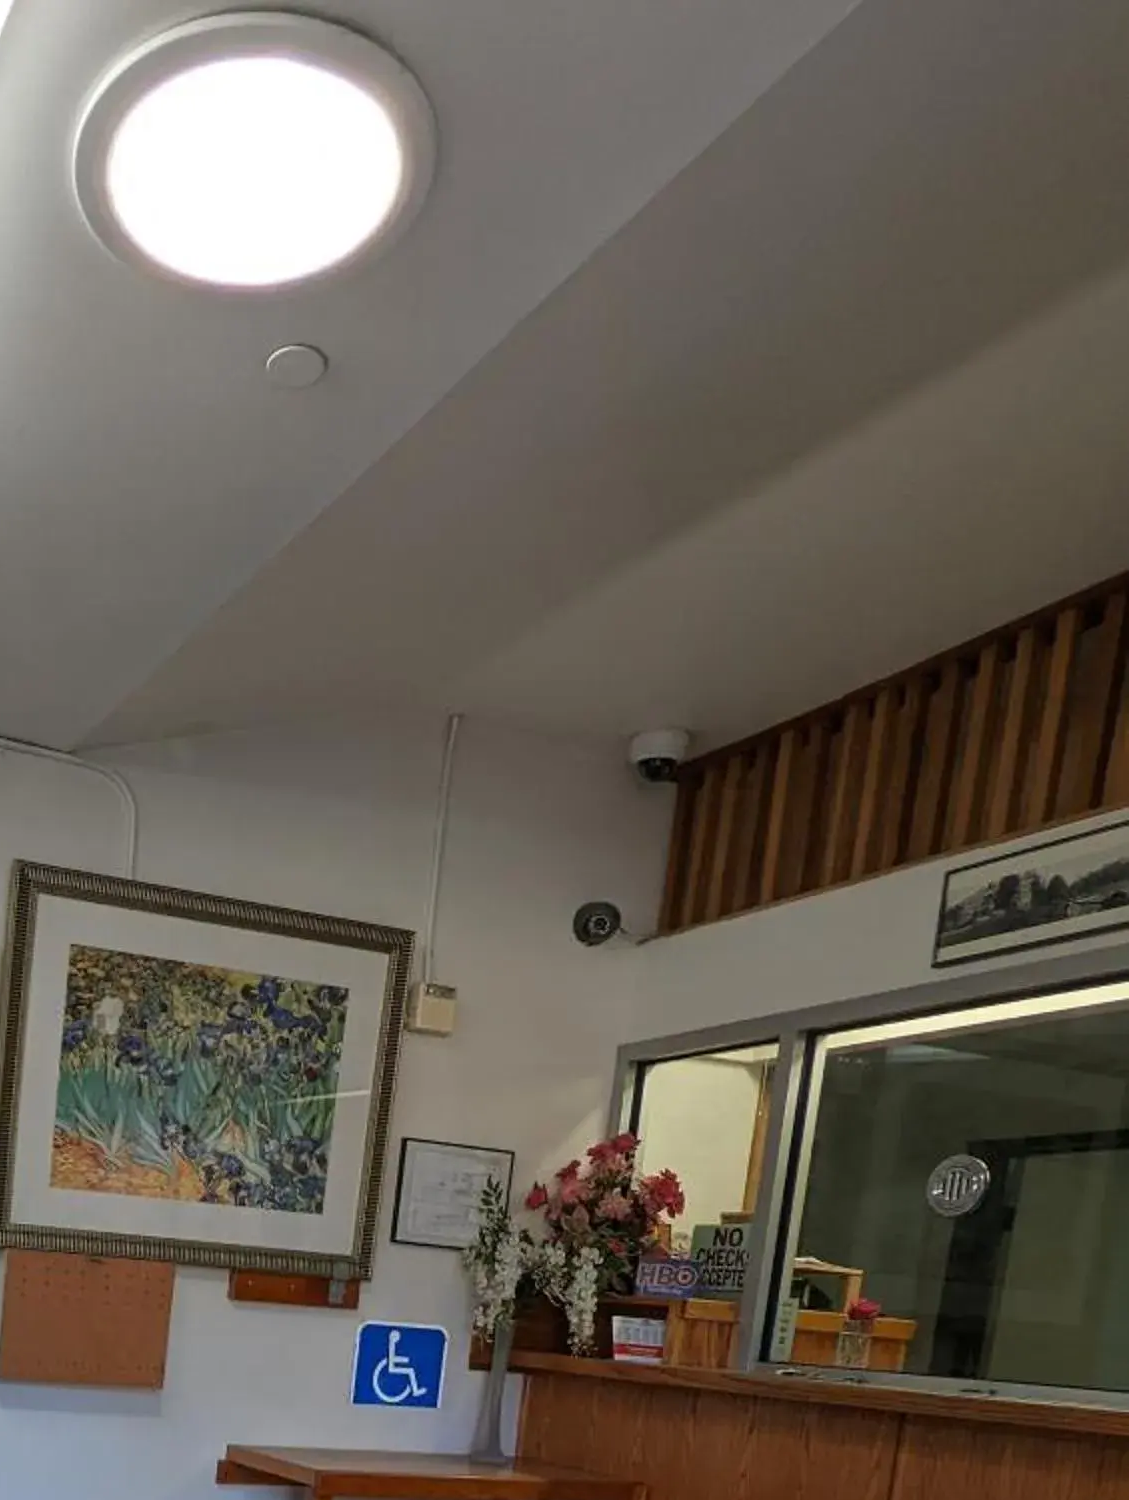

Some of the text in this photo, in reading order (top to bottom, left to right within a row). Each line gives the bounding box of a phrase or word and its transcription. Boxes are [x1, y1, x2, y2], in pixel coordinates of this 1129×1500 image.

[712, 1227, 744, 1247] NO
[637, 1262, 698, 1288] HBO
[701, 1267, 745, 1288] CCEPTE
